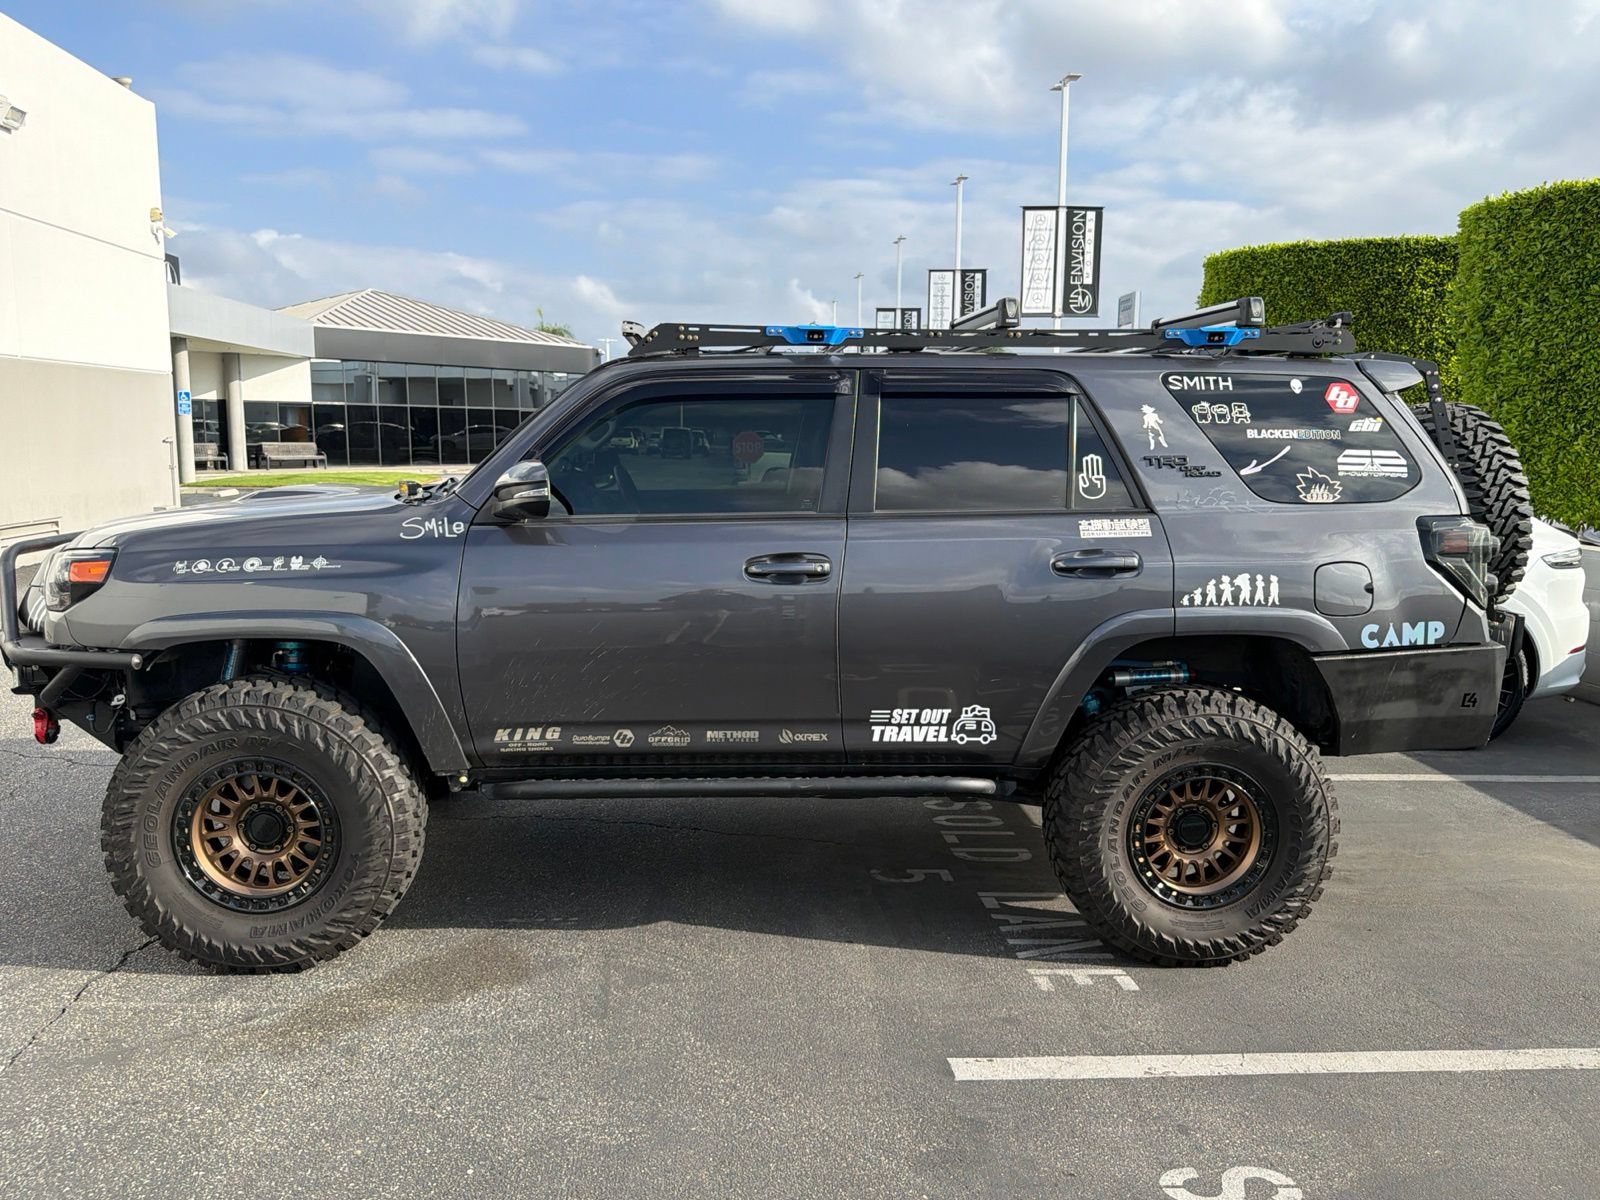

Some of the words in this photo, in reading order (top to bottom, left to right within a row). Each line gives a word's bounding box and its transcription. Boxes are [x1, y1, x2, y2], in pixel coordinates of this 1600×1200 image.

[1070, 210, 1086, 285] ENVISION
[1085, 217, 1094, 279] MOTORS
[964, 272, 974, 314] VISION
[1168, 375, 1233, 391] SMITH
[1144, 455, 1189, 469] TRD
[1361, 620, 1446, 649] CAMP
[890, 708, 920, 724] SET
[920, 708, 952, 724] OUT
[494, 726, 562, 742] KING
[706, 730, 760, 739] METHOD
[871, 725, 949, 742] TRAVEL
[923, 799, 1033, 862] SOLD
[976, 892, 1140, 991] LANE
